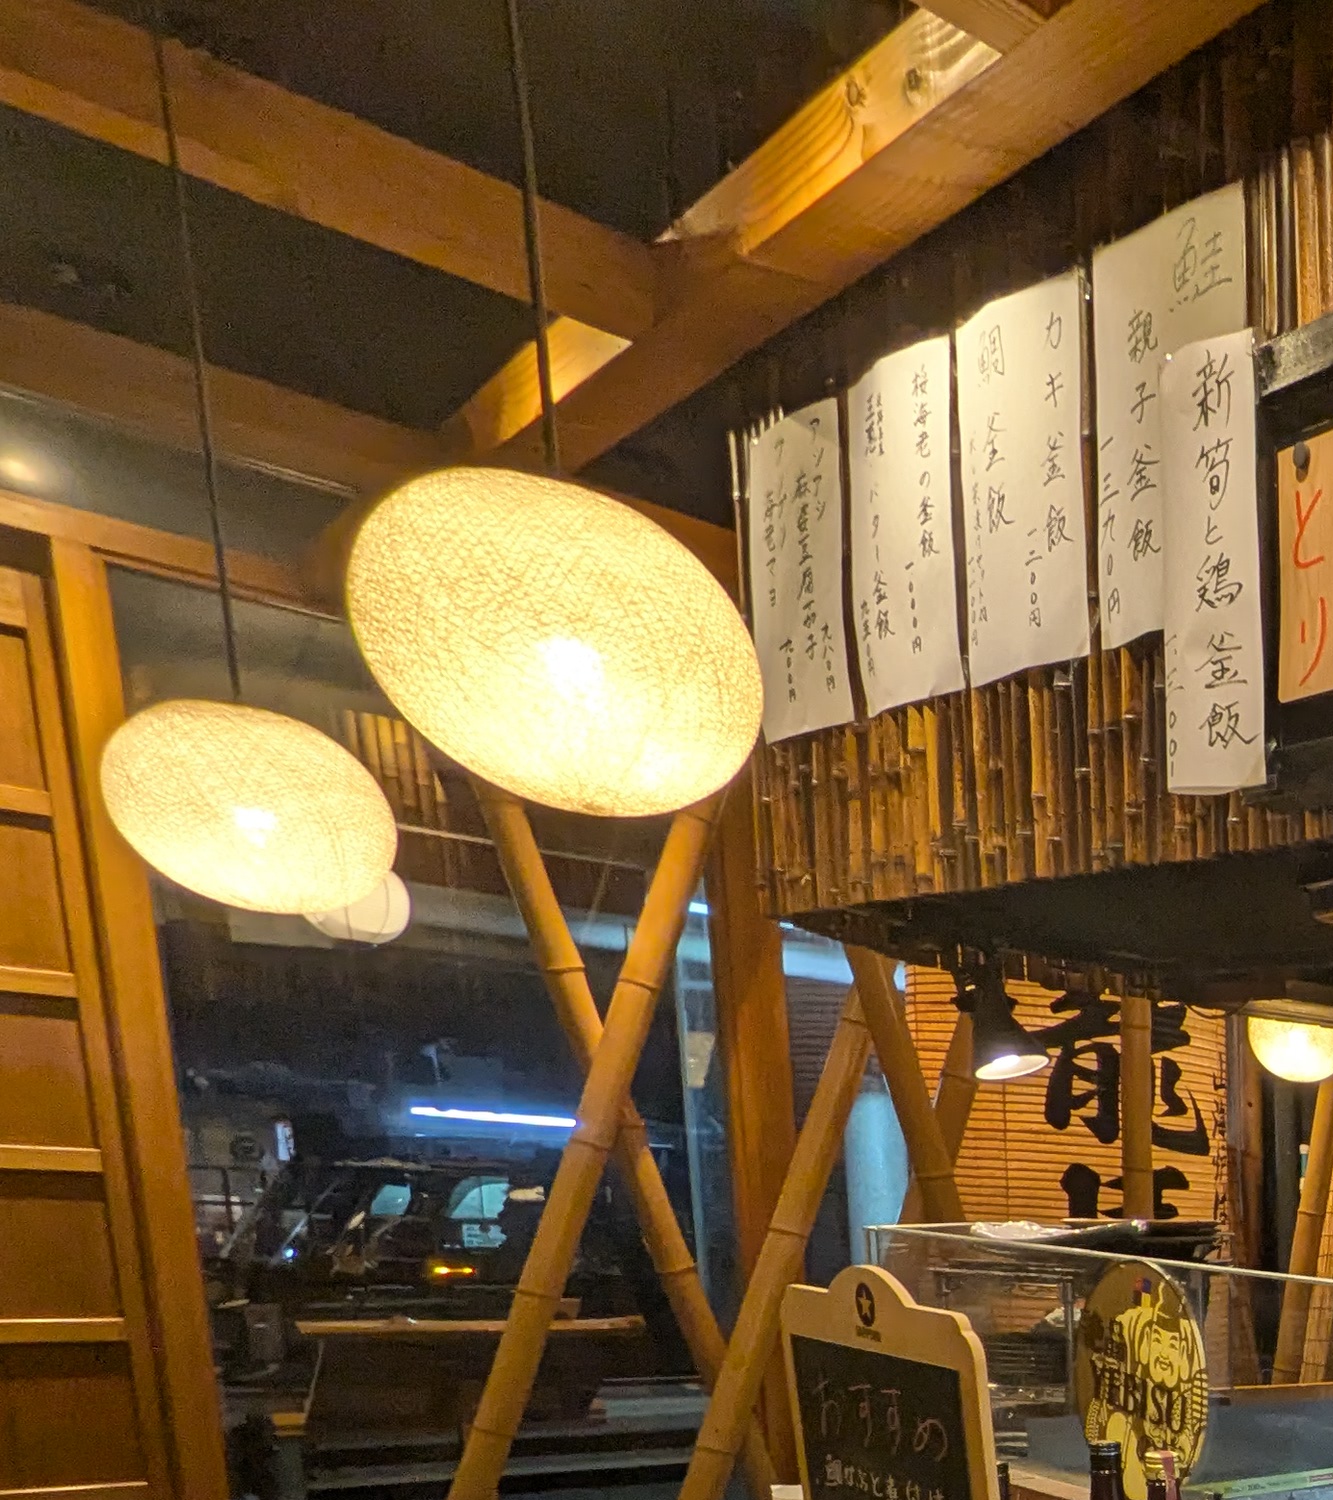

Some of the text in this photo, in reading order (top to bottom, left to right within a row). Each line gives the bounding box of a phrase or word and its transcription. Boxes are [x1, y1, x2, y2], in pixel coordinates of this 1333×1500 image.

[1040, 311, 1075, 552] カキ釜飯
[1127, 308, 1162, 563] 親子釜飯
[1293, 488, 1328, 686] とり
